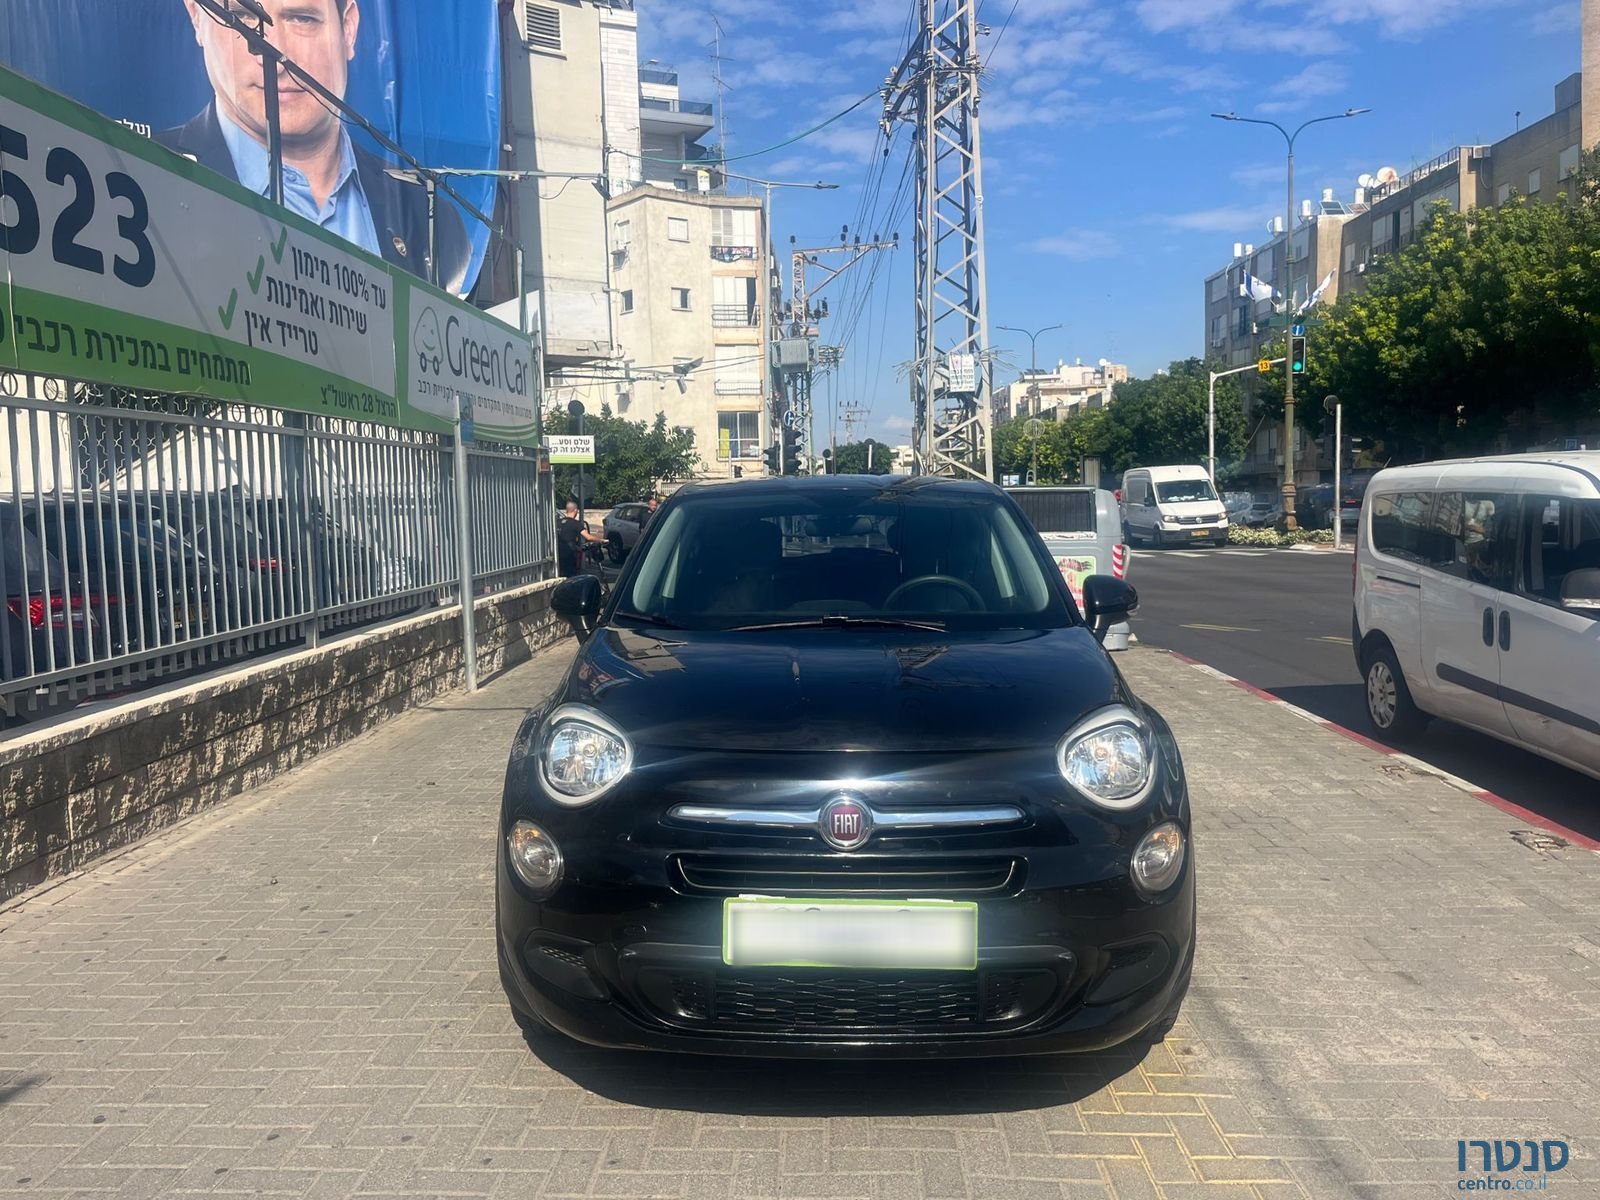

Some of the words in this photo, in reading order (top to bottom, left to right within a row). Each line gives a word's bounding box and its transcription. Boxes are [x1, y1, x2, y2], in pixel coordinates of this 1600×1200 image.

[292, 246, 330, 286] מימון
[334, 263, 369, 302] 100%
[266, 275, 326, 321] ואמינות
[371, 283, 386, 310] עד
[13, 313, 77, 357] רכבי
[244, 309, 273, 347] אין
[328, 299, 367, 335] שירות
[84, 327, 171, 373] במכירת
[276, 319, 318, 355] טרייד
[176, 347, 251, 385] מתמחים
[446, 315, 502, 389] Green
[504, 341, 528, 397] Car
[361, 392, 374, 413] 28
[418, 379, 431, 395] רכב
[375, 394, 397, 418] הרצל
[560, 446, 568, 454] זה
[570, 446, 590, 454] אצלנו
[573, 438, 590, 446] שלם
[834, 813, 859, 834] FIAT
